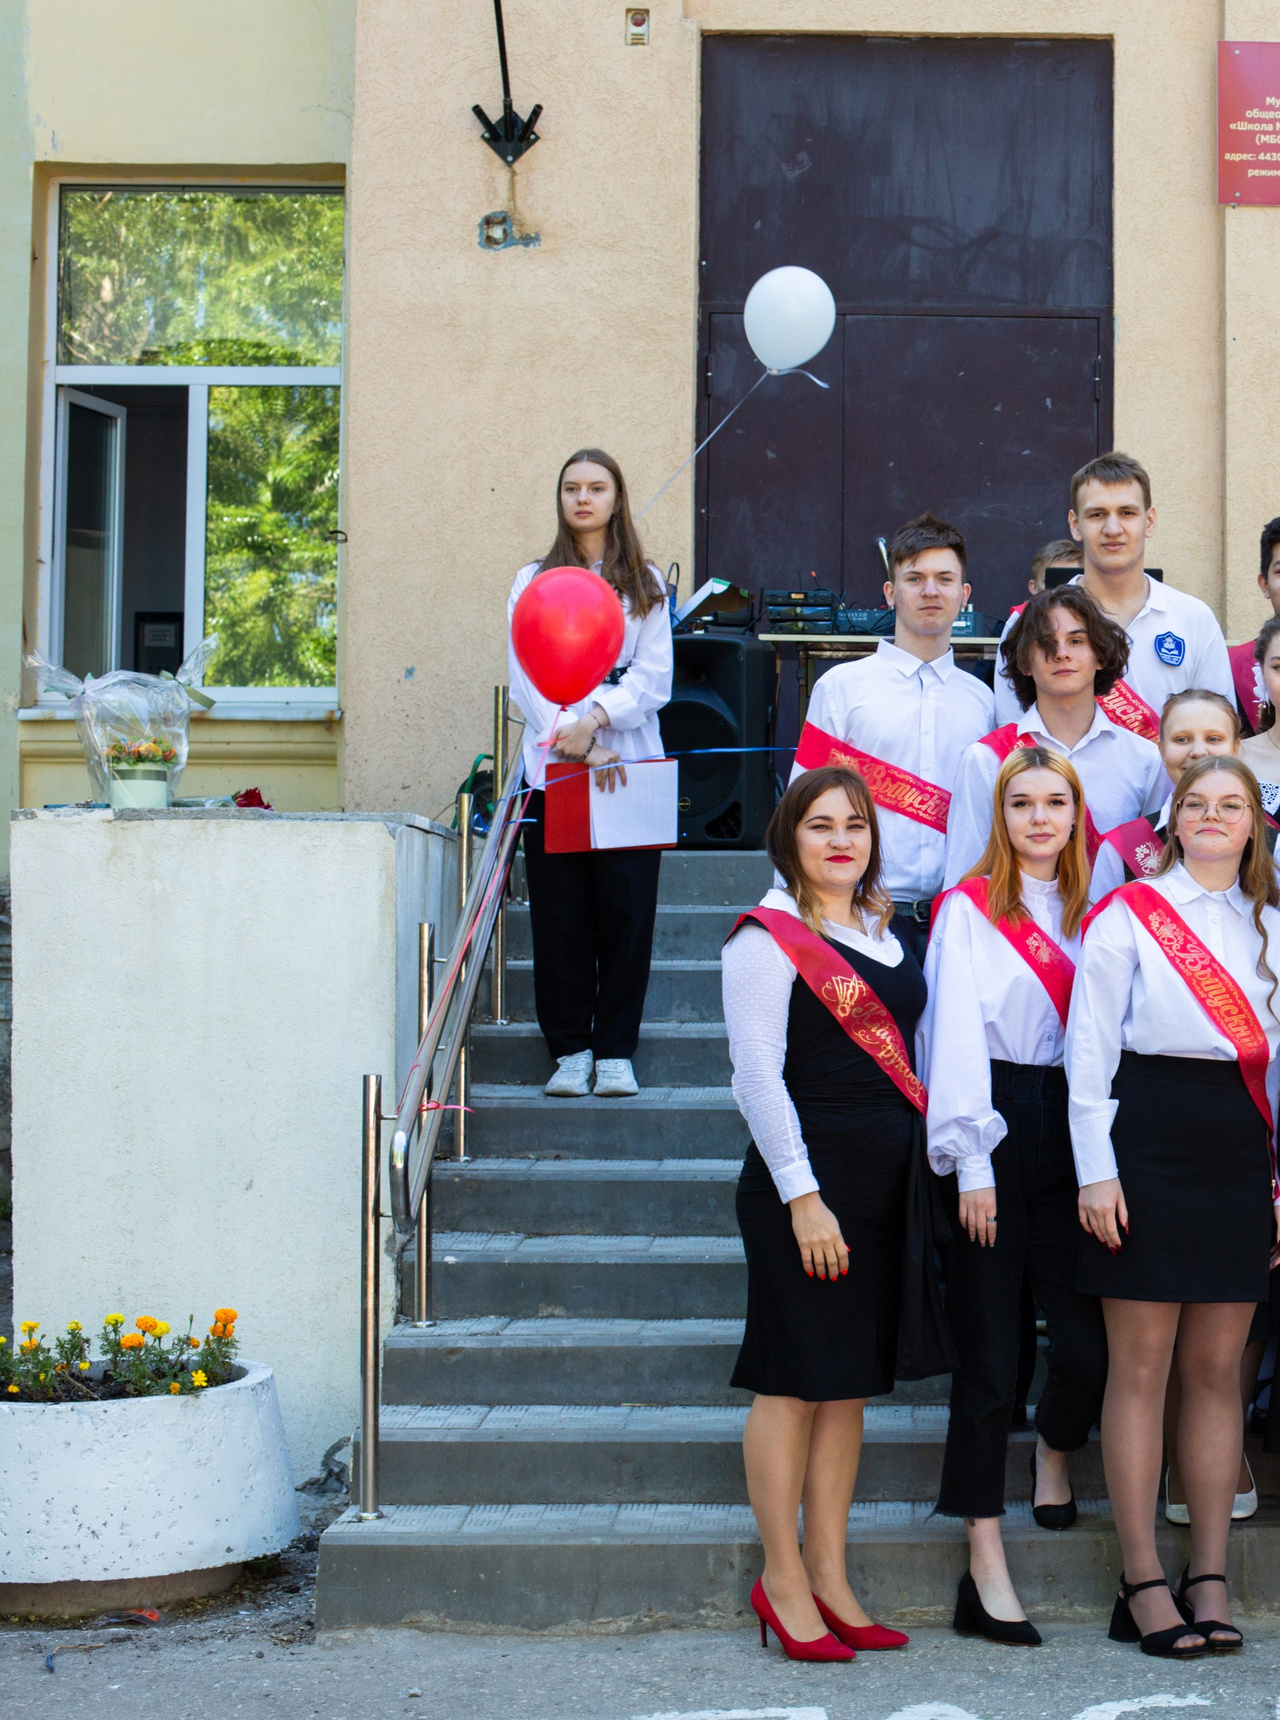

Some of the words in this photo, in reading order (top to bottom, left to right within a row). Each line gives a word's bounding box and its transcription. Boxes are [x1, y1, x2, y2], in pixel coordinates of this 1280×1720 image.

[1229, 122, 1273, 131] «Школа
[1224, 153, 1256, 162] адрес:
[1248, 168, 1280, 178] режим
